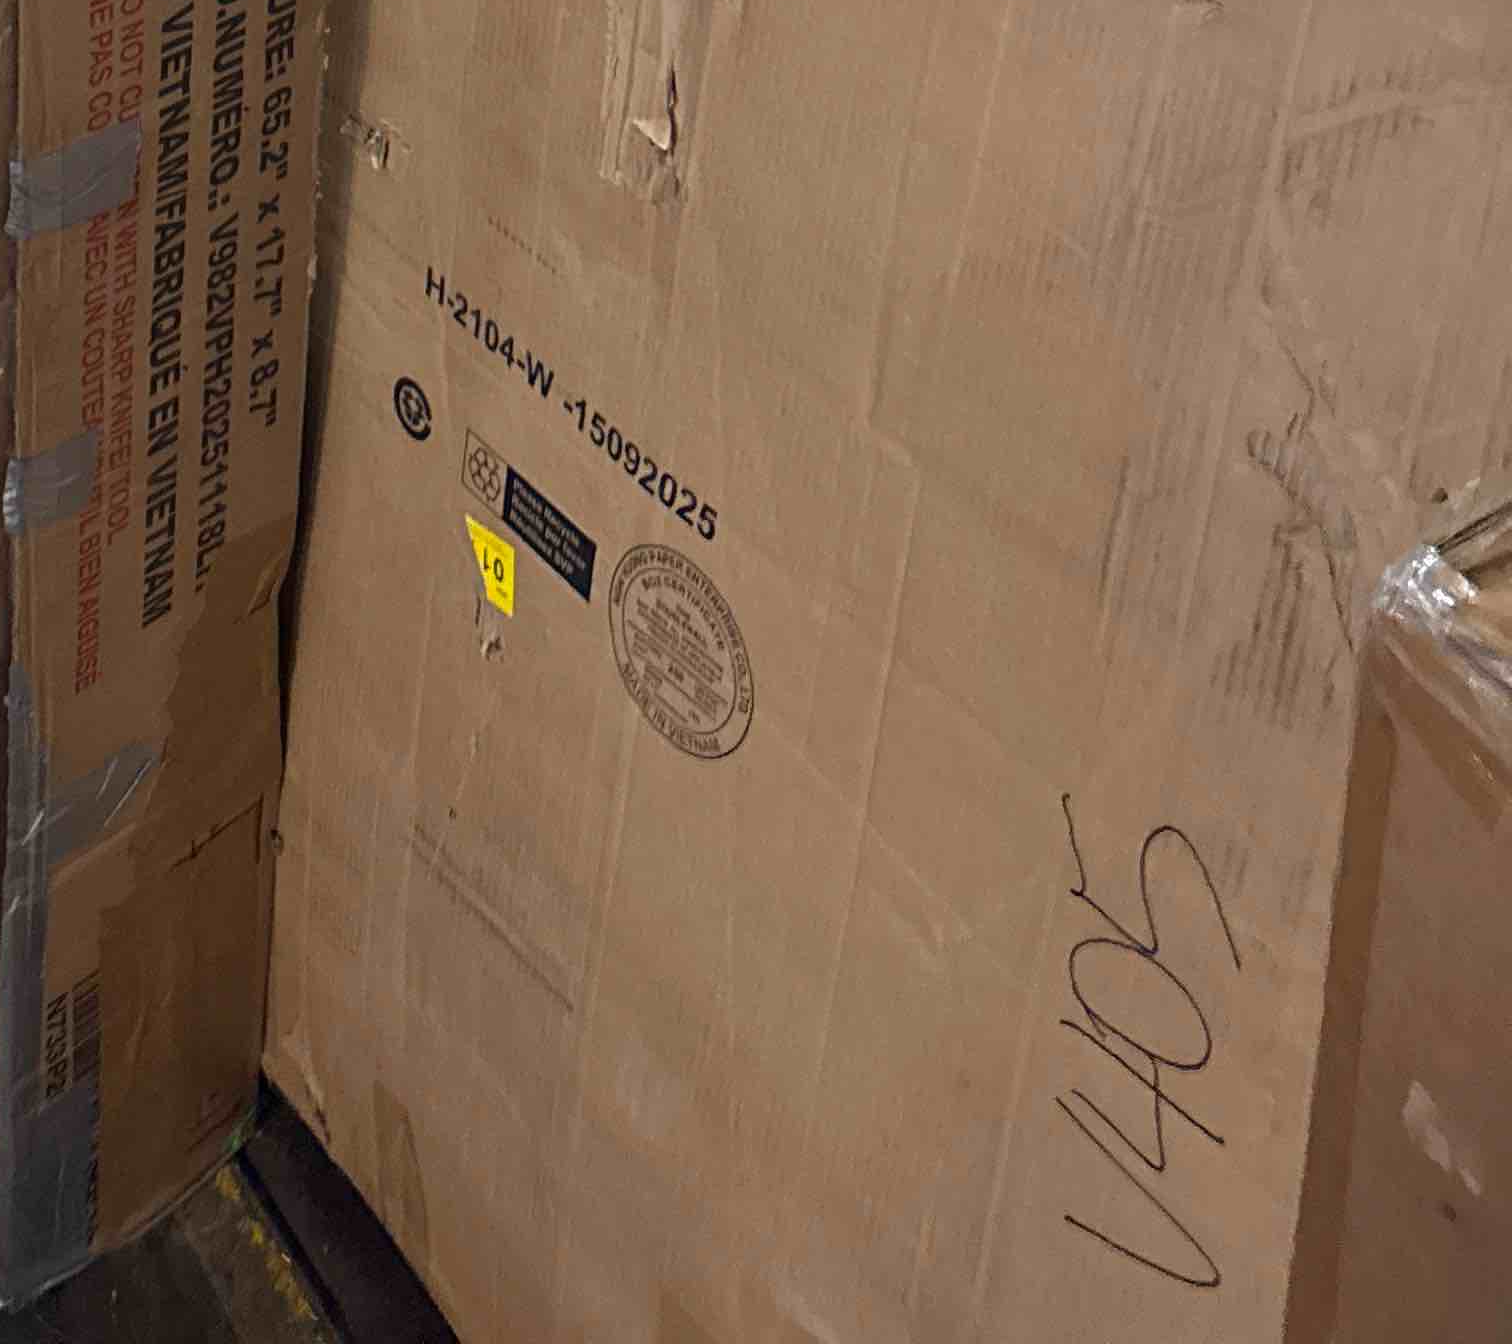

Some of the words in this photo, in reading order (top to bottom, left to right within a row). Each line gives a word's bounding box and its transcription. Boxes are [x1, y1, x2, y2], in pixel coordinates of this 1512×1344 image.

[88, 30, 113, 88] PAS
[119, 21, 144, 78] NOT
[118, 84, 143, 130] CU
[110, 295, 136, 382] SHARP
[147, 400, 179, 456] EN
[425, 266, 555, 398] H-2104-W
[563, 399, 719, 542] -15092025
[141, 457, 178, 629] VIETNAM
